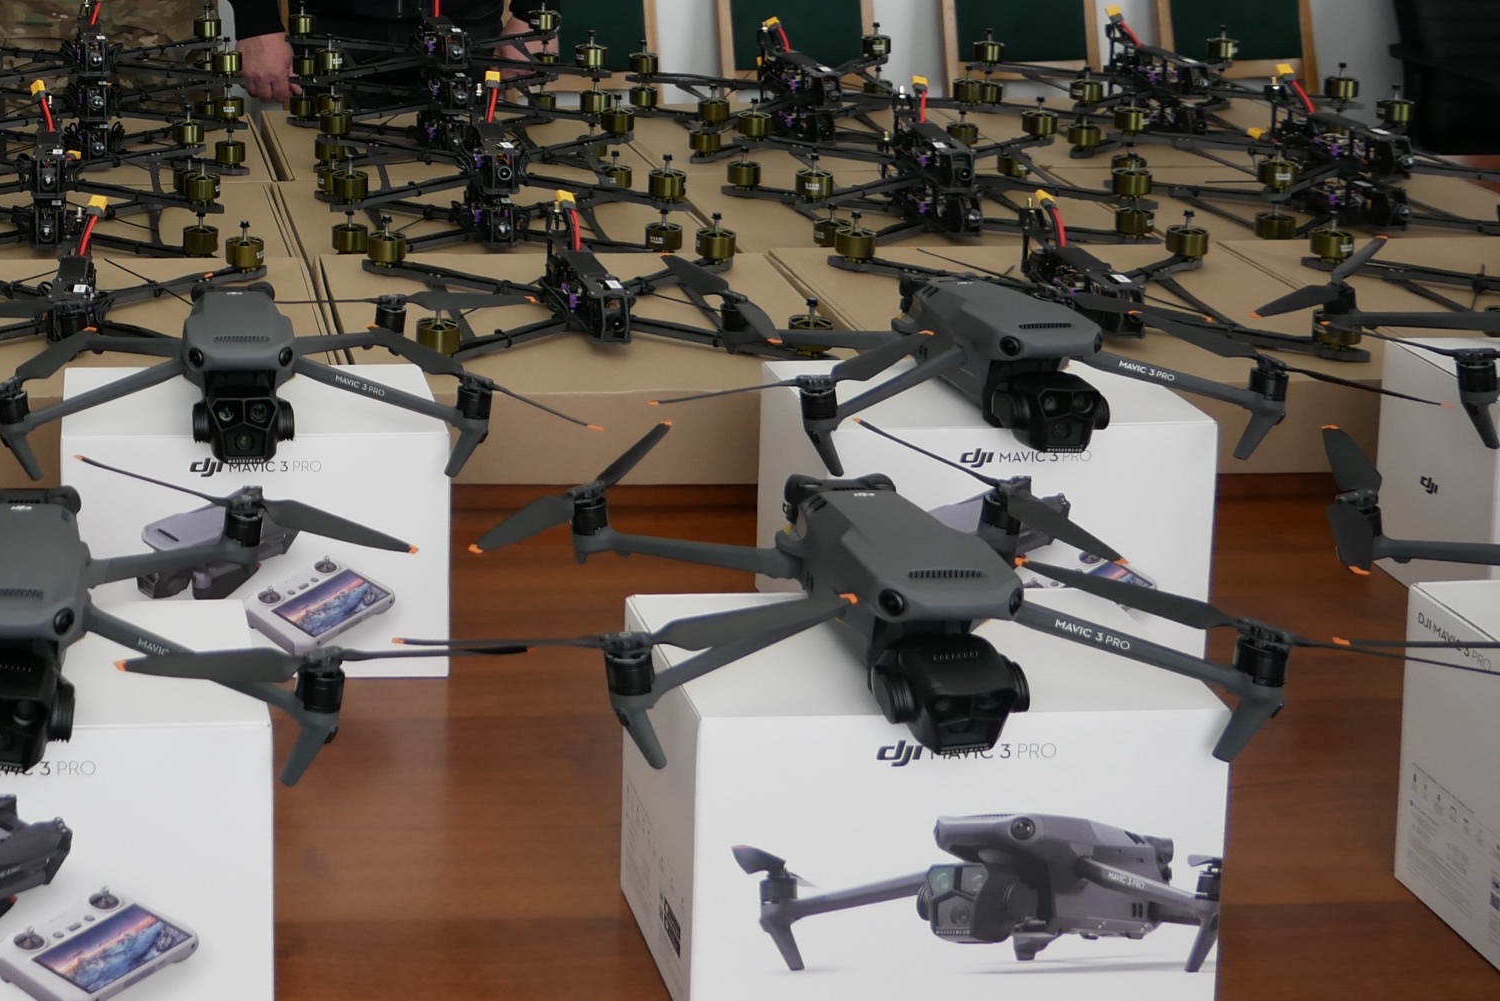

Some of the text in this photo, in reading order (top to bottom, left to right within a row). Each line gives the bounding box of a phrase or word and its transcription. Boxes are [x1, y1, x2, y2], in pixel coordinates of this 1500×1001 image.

[1118, 360, 1175, 382] MAVIC 3 PRO
[335, 374, 386, 397] MAVIC 3 PRO
[999, 451, 1046, 463] MAVIC
[1062, 450, 1092, 462] PRO
[228, 461, 276, 472] MAVIC
[279, 460, 289, 473] 3
[292, 460, 322, 473] PRO
[1054, 618, 1130, 650] MAVIC 3 PRO
[999, 743, 1012, 759] 3
[1016, 742, 1057, 759] PRO
[39, 760, 51, 776] 3
[56, 760, 97, 776] PRO
